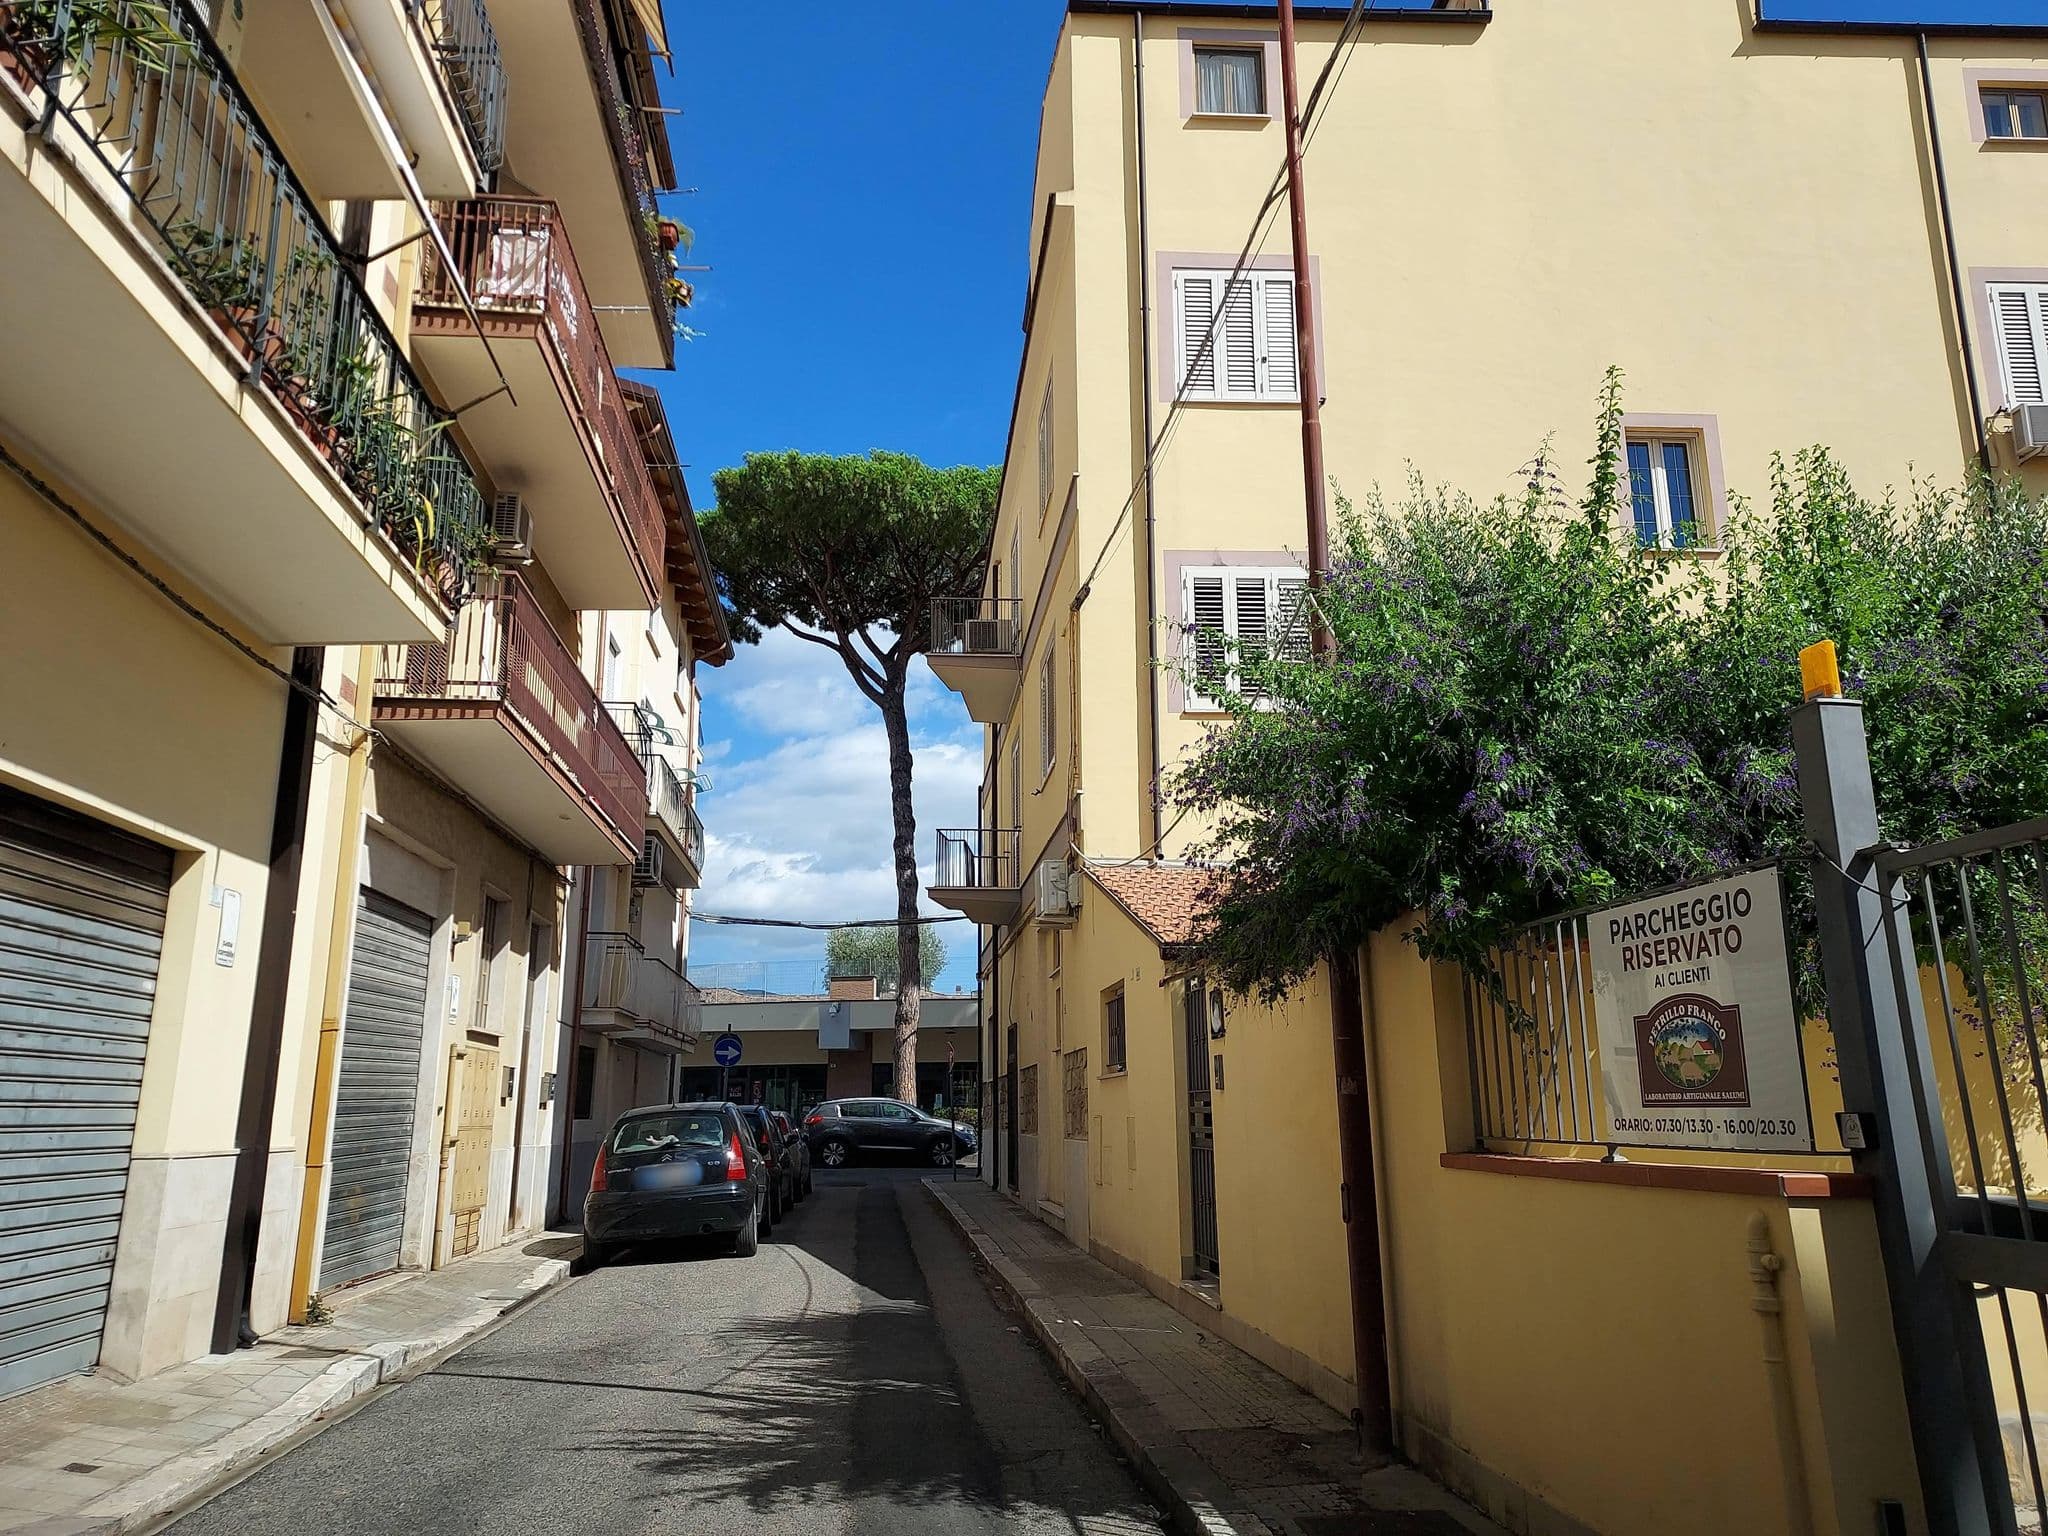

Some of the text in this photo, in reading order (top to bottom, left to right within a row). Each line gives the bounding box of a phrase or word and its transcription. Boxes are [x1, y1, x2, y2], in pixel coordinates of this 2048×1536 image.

[1609, 887, 1752, 945] PARCHEGGIO
[1621, 924, 1742, 972] RISERVATO
[1654, 966, 1711, 989] AI CLIENTI
[1648, 1004, 1727, 1047] PETRILLO FRANCO
[1644, 1092, 1682, 1101] LABORATORIO
[1682, 1091, 1721, 1100] ARTIGIANALE
[1614, 1118, 1653, 1132] ORARIO:
[1655, 1117, 1714, 1135] 07.30/13.30
[1723, 1118, 1797, 1137] 16.00/20.30
